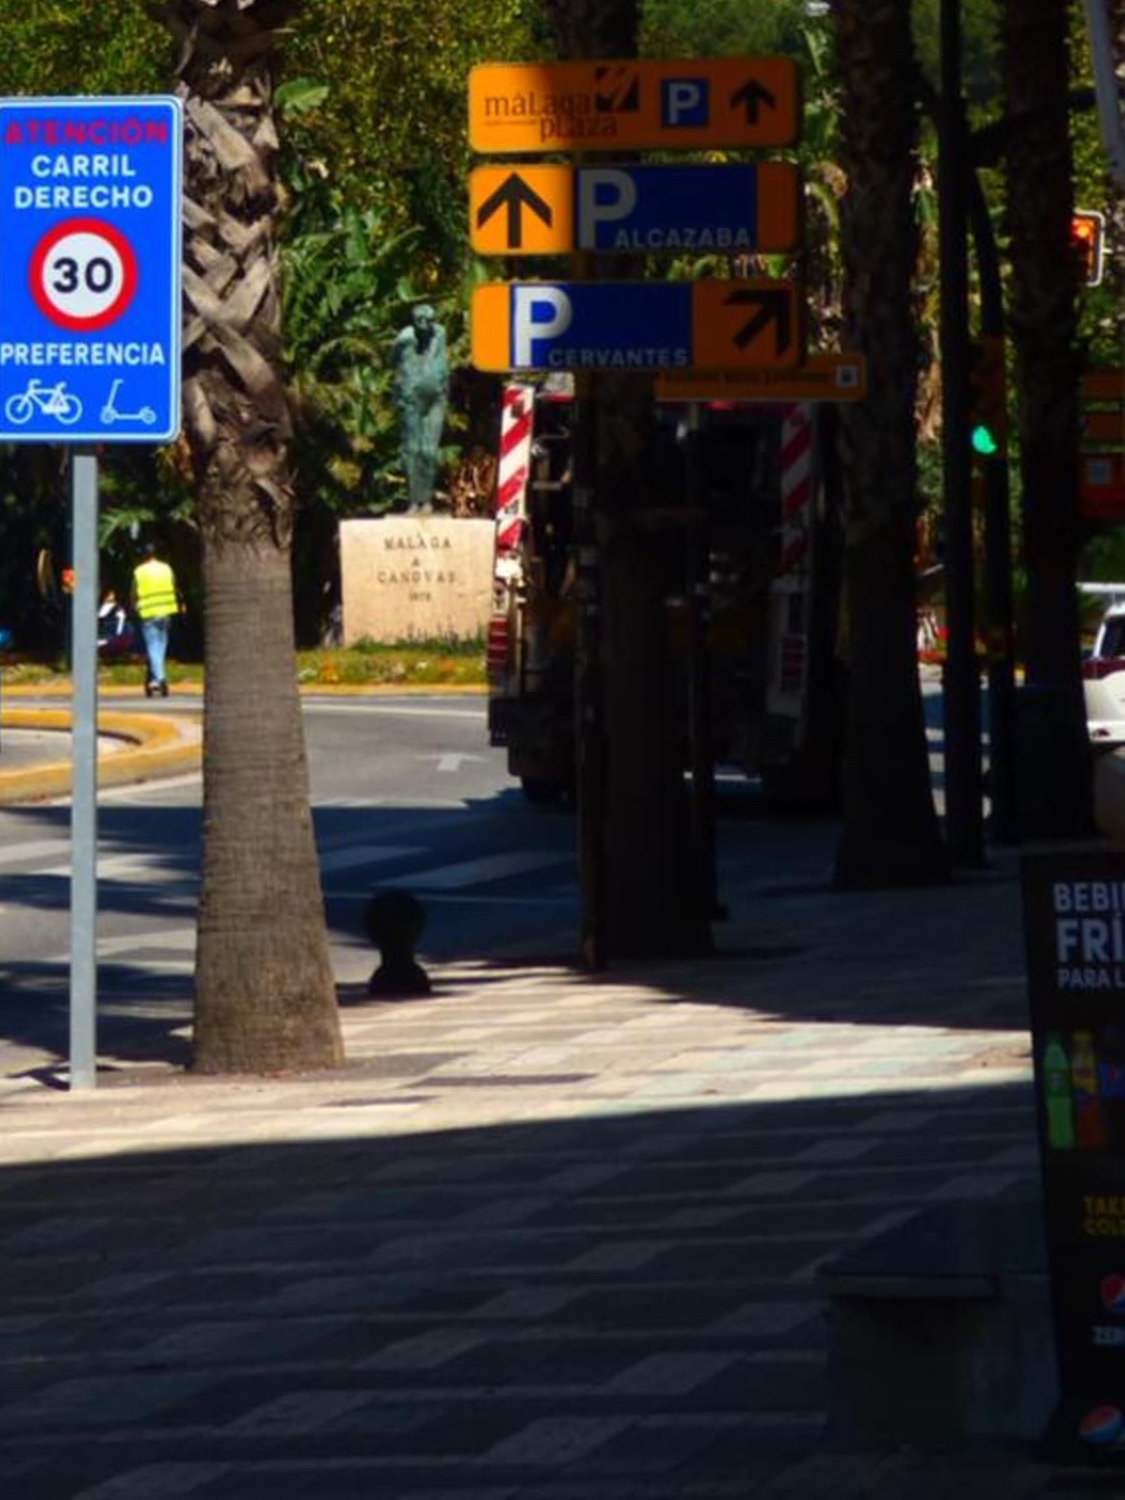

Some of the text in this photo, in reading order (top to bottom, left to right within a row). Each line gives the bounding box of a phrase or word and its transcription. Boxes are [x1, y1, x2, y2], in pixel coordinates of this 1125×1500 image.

[30, 154, 137, 178] CARRIL
[13, 185, 154, 209] DERECHO
[614, 228, 752, 249] ALCAZABA
[52, 257, 114, 294] 30
[0, 343, 166, 367] PREFERENCIA
[547, 348, 688, 369] CERVANTES
[1053, 882, 1125, 912] BEBI
[1058, 966, 1111, 989] PARA
